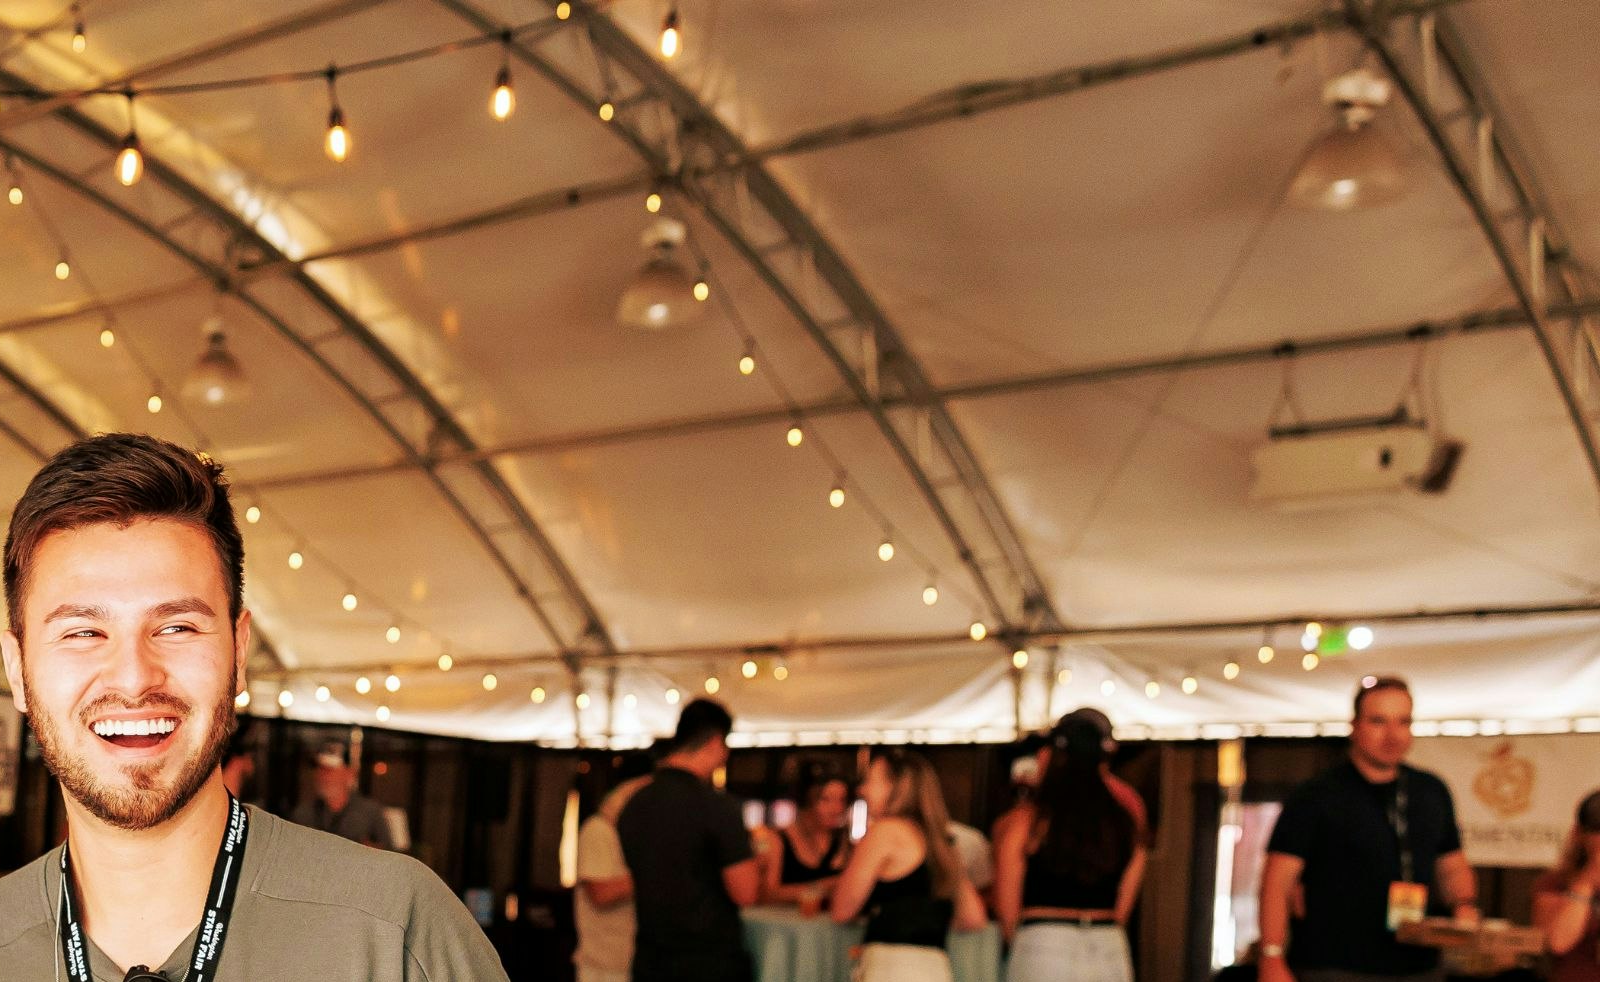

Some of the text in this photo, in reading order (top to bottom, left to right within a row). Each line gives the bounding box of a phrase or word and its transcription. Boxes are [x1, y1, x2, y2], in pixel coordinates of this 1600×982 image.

[69, 921, 88, 982] STATE FAIR
[194, 909, 218, 971] STATE FAIR
[205, 921, 225, 961] Washington
